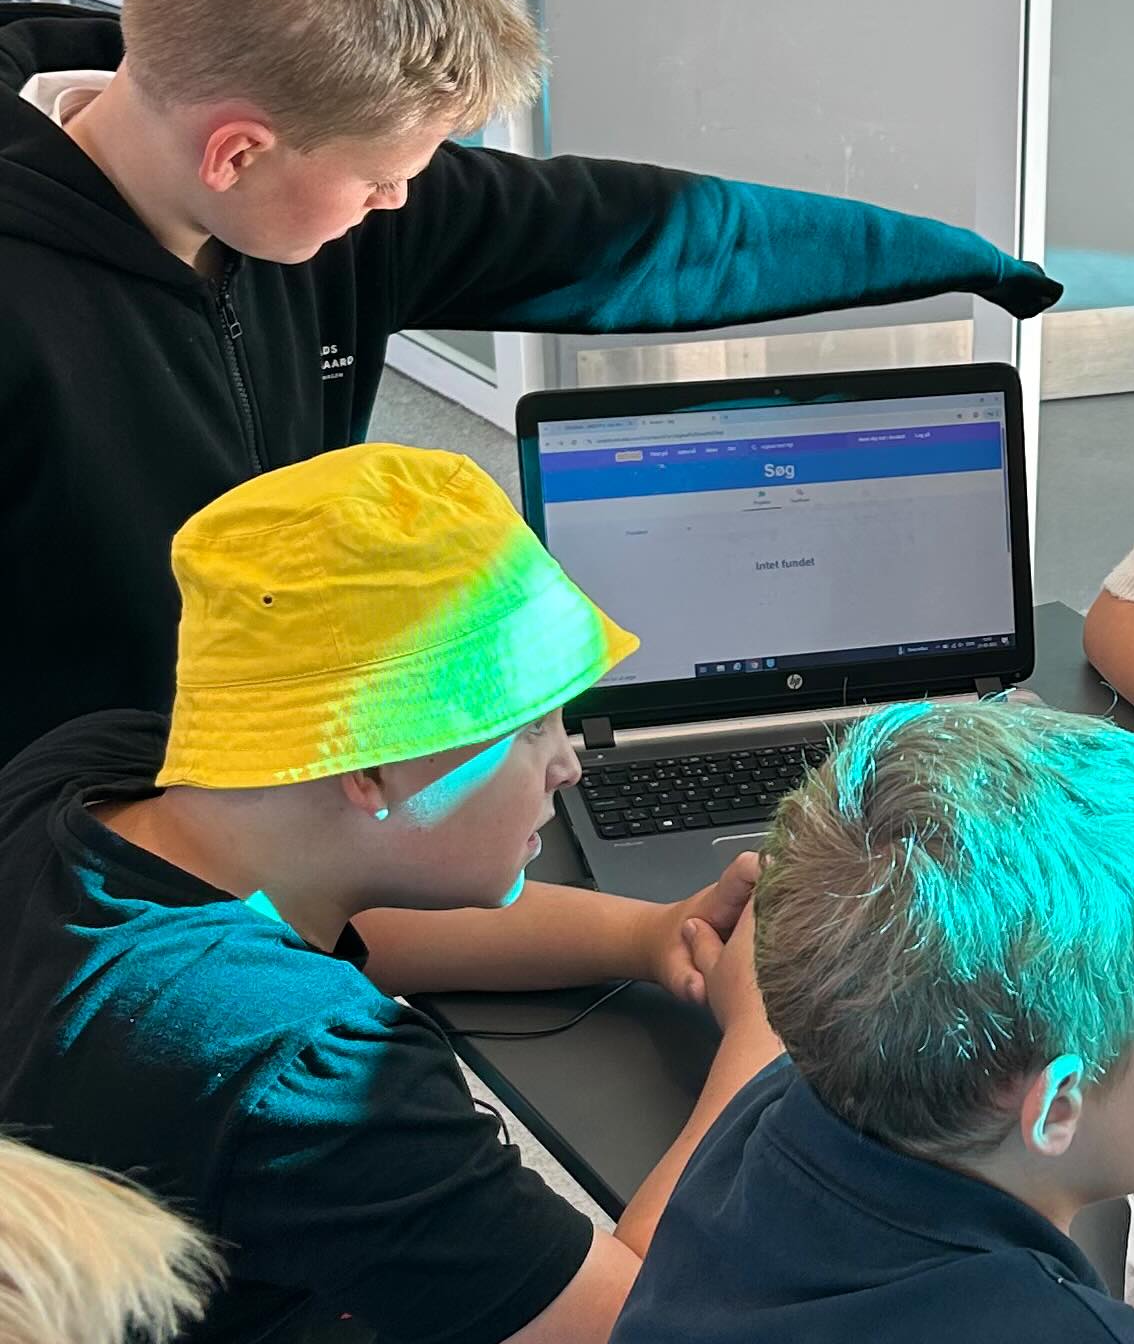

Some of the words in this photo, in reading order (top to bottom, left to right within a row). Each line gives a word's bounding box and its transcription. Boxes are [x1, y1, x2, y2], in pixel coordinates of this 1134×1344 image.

[764, 463, 796, 479] Søg
[755, 560, 779, 570] Intet
[781, 557, 815, 569] fundet
